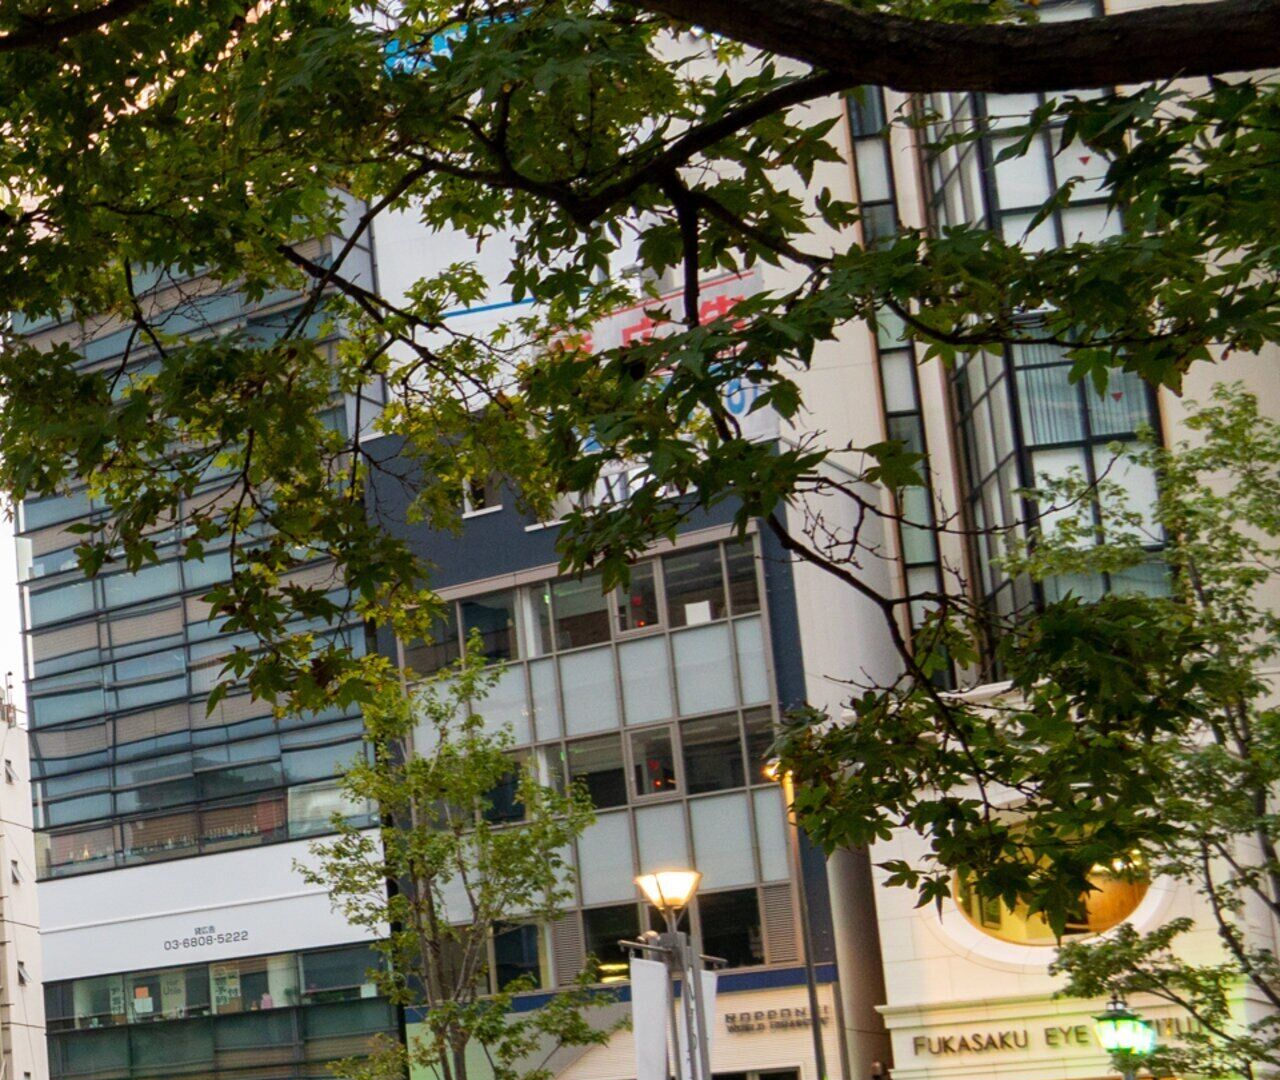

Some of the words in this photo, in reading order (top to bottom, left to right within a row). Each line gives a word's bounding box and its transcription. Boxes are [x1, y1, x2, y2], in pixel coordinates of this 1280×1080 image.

[163, 930, 249, 951] 03-6808-5222
[912, 1029, 1029, 1056] FUKASAKU
[1043, 1024, 1090, 1046] EYE
